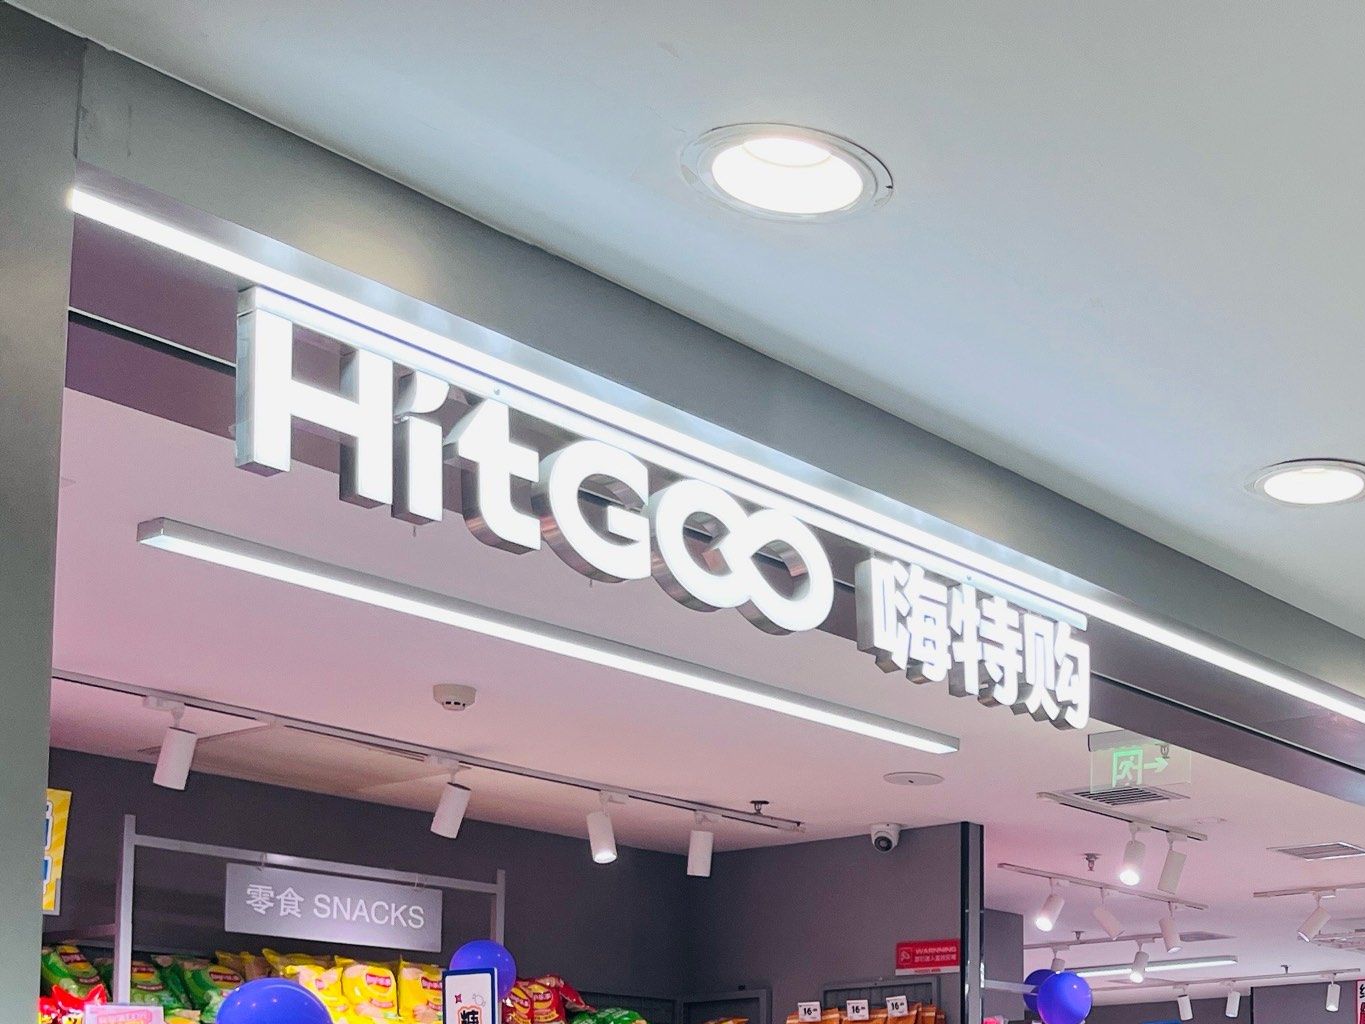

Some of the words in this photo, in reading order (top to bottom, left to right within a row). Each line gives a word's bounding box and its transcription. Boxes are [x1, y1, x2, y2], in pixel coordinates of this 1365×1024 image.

[857, 553, 1090, 731] 嗨特购
[246, 884, 304, 918] 零食
[313, 894, 425, 929] SNACKS
